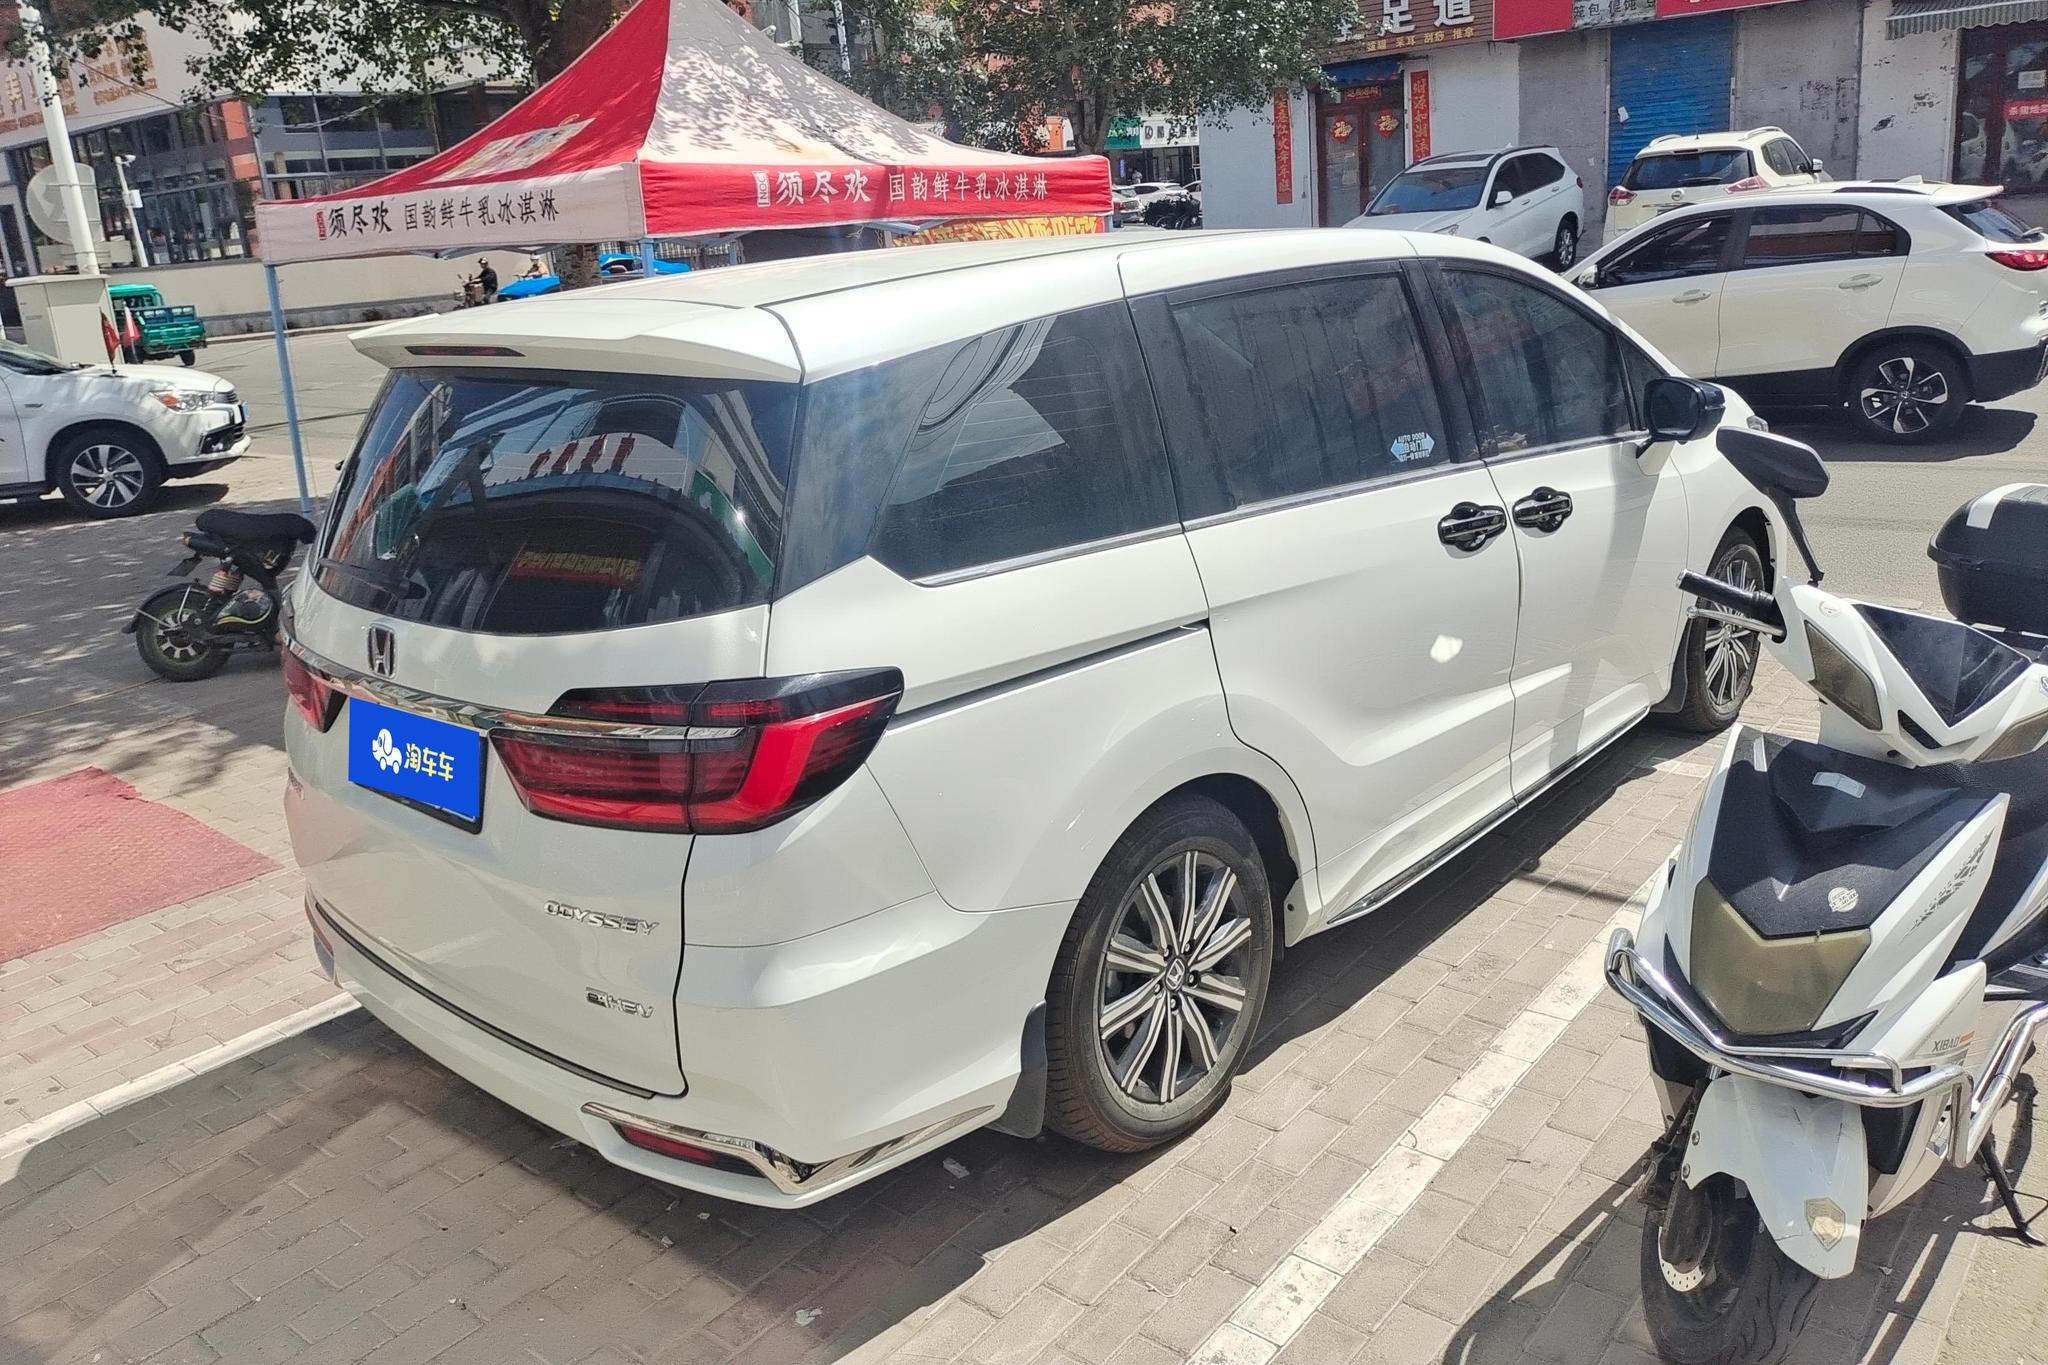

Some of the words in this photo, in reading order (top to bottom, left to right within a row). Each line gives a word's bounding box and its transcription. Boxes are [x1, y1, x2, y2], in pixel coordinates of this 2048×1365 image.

[1395, 35, 1416, 48] 采耳
[1424, 31, 1445, 44] 刮痧
[1453, 26, 1474, 40] 推拿
[776, 168, 872, 206] 须尽欢
[889, 171, 1048, 203] 国韵鲜牛乳冰淇淋
[328, 200, 392, 239] 须尽欢
[405, 190, 560, 231] 国韵鲜牛乳冰淇淋
[1412, 432, 1425, 441] DOOR
[544, 900, 660, 935] ODYSSEY
